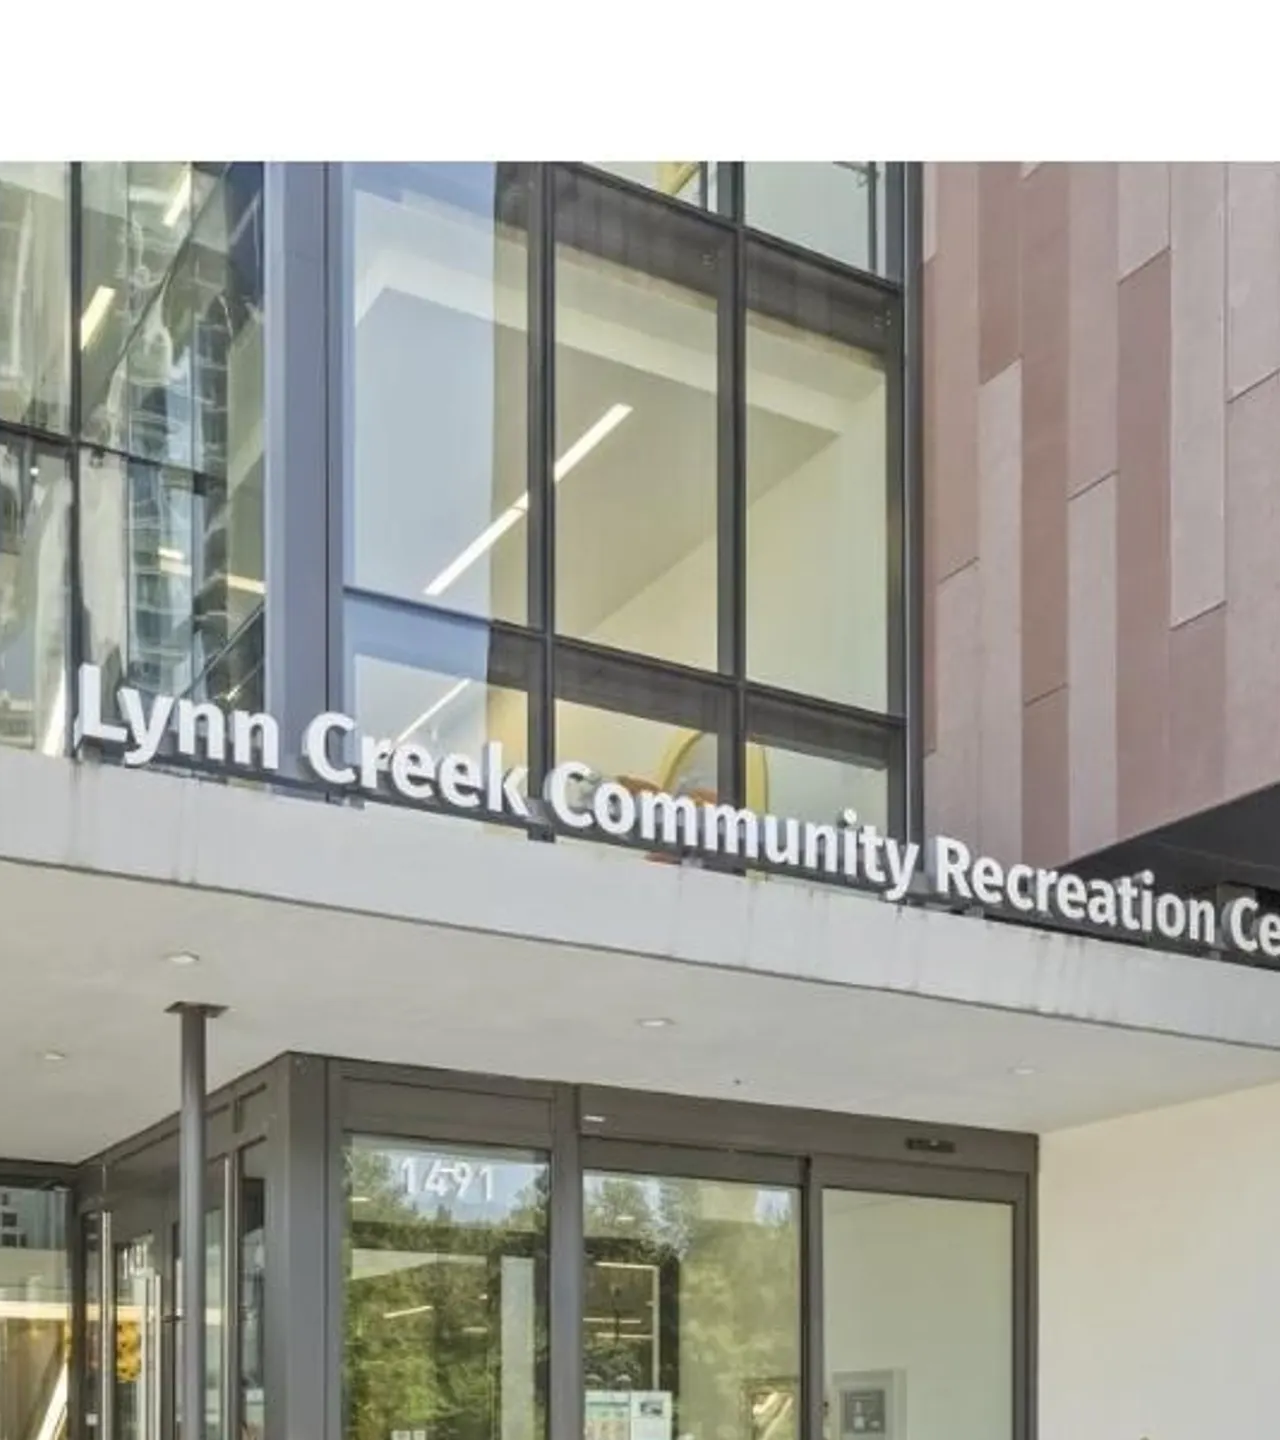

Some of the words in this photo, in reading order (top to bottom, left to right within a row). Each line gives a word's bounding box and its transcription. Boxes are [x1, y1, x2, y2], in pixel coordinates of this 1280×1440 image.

[76, 663, 280, 770] Lynn
[303, 711, 530, 817] Creek
[545, 761, 920, 901] Community
[934, 835, 1216, 943] Recreation
[400, 1157, 495, 1202] 1491
